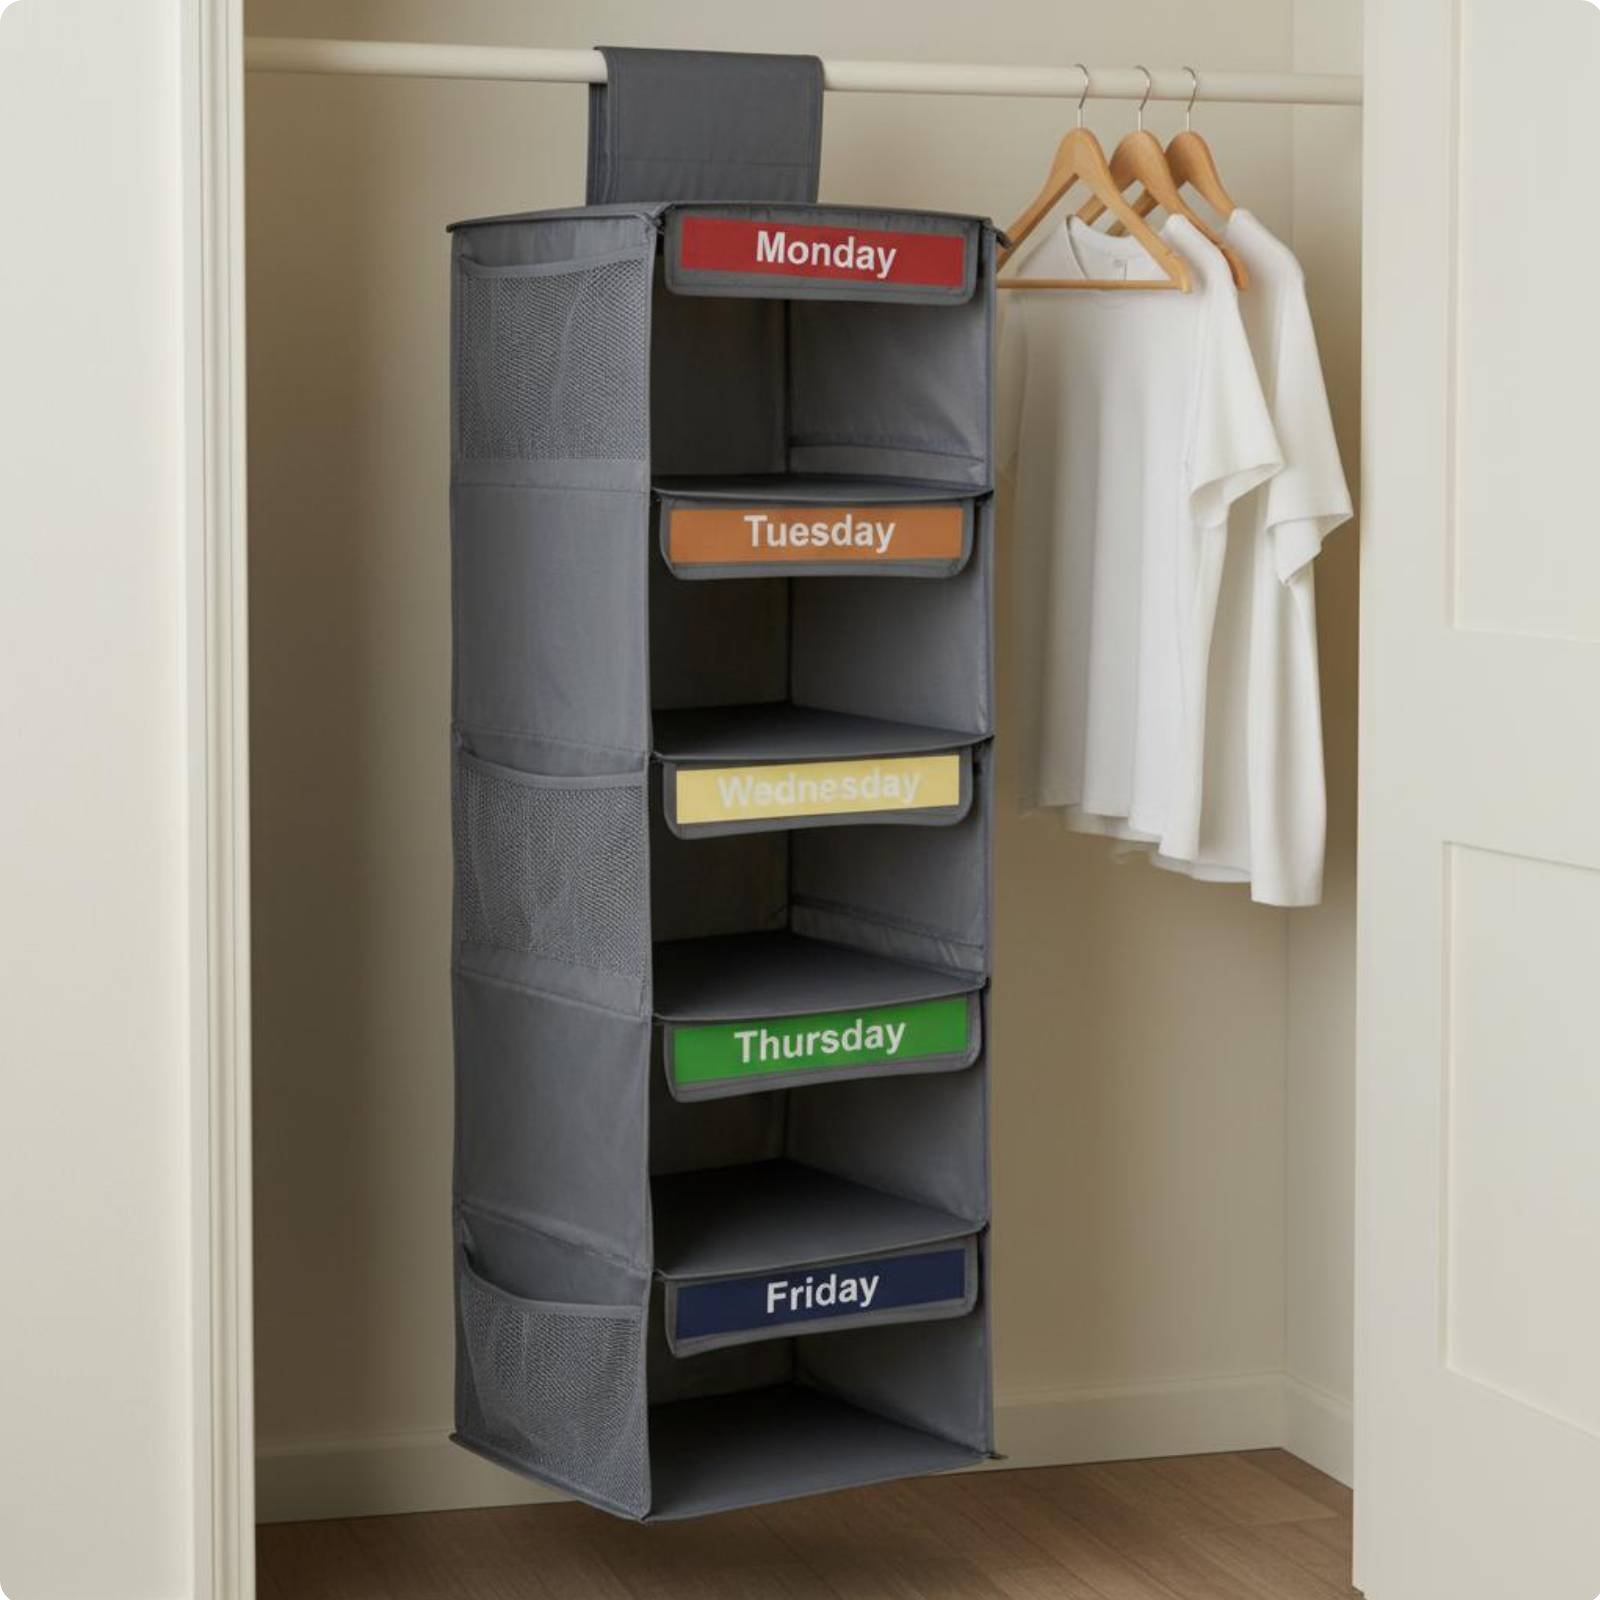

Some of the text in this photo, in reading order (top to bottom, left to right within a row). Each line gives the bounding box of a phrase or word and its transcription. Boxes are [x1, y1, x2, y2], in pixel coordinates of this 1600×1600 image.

[756, 230, 897, 279] Monday
[744, 513, 896, 554] Tuesday
[717, 768, 922, 809] Wednesday
[735, 1020, 906, 1063] Thursday
[766, 1272, 880, 1314] Friday
